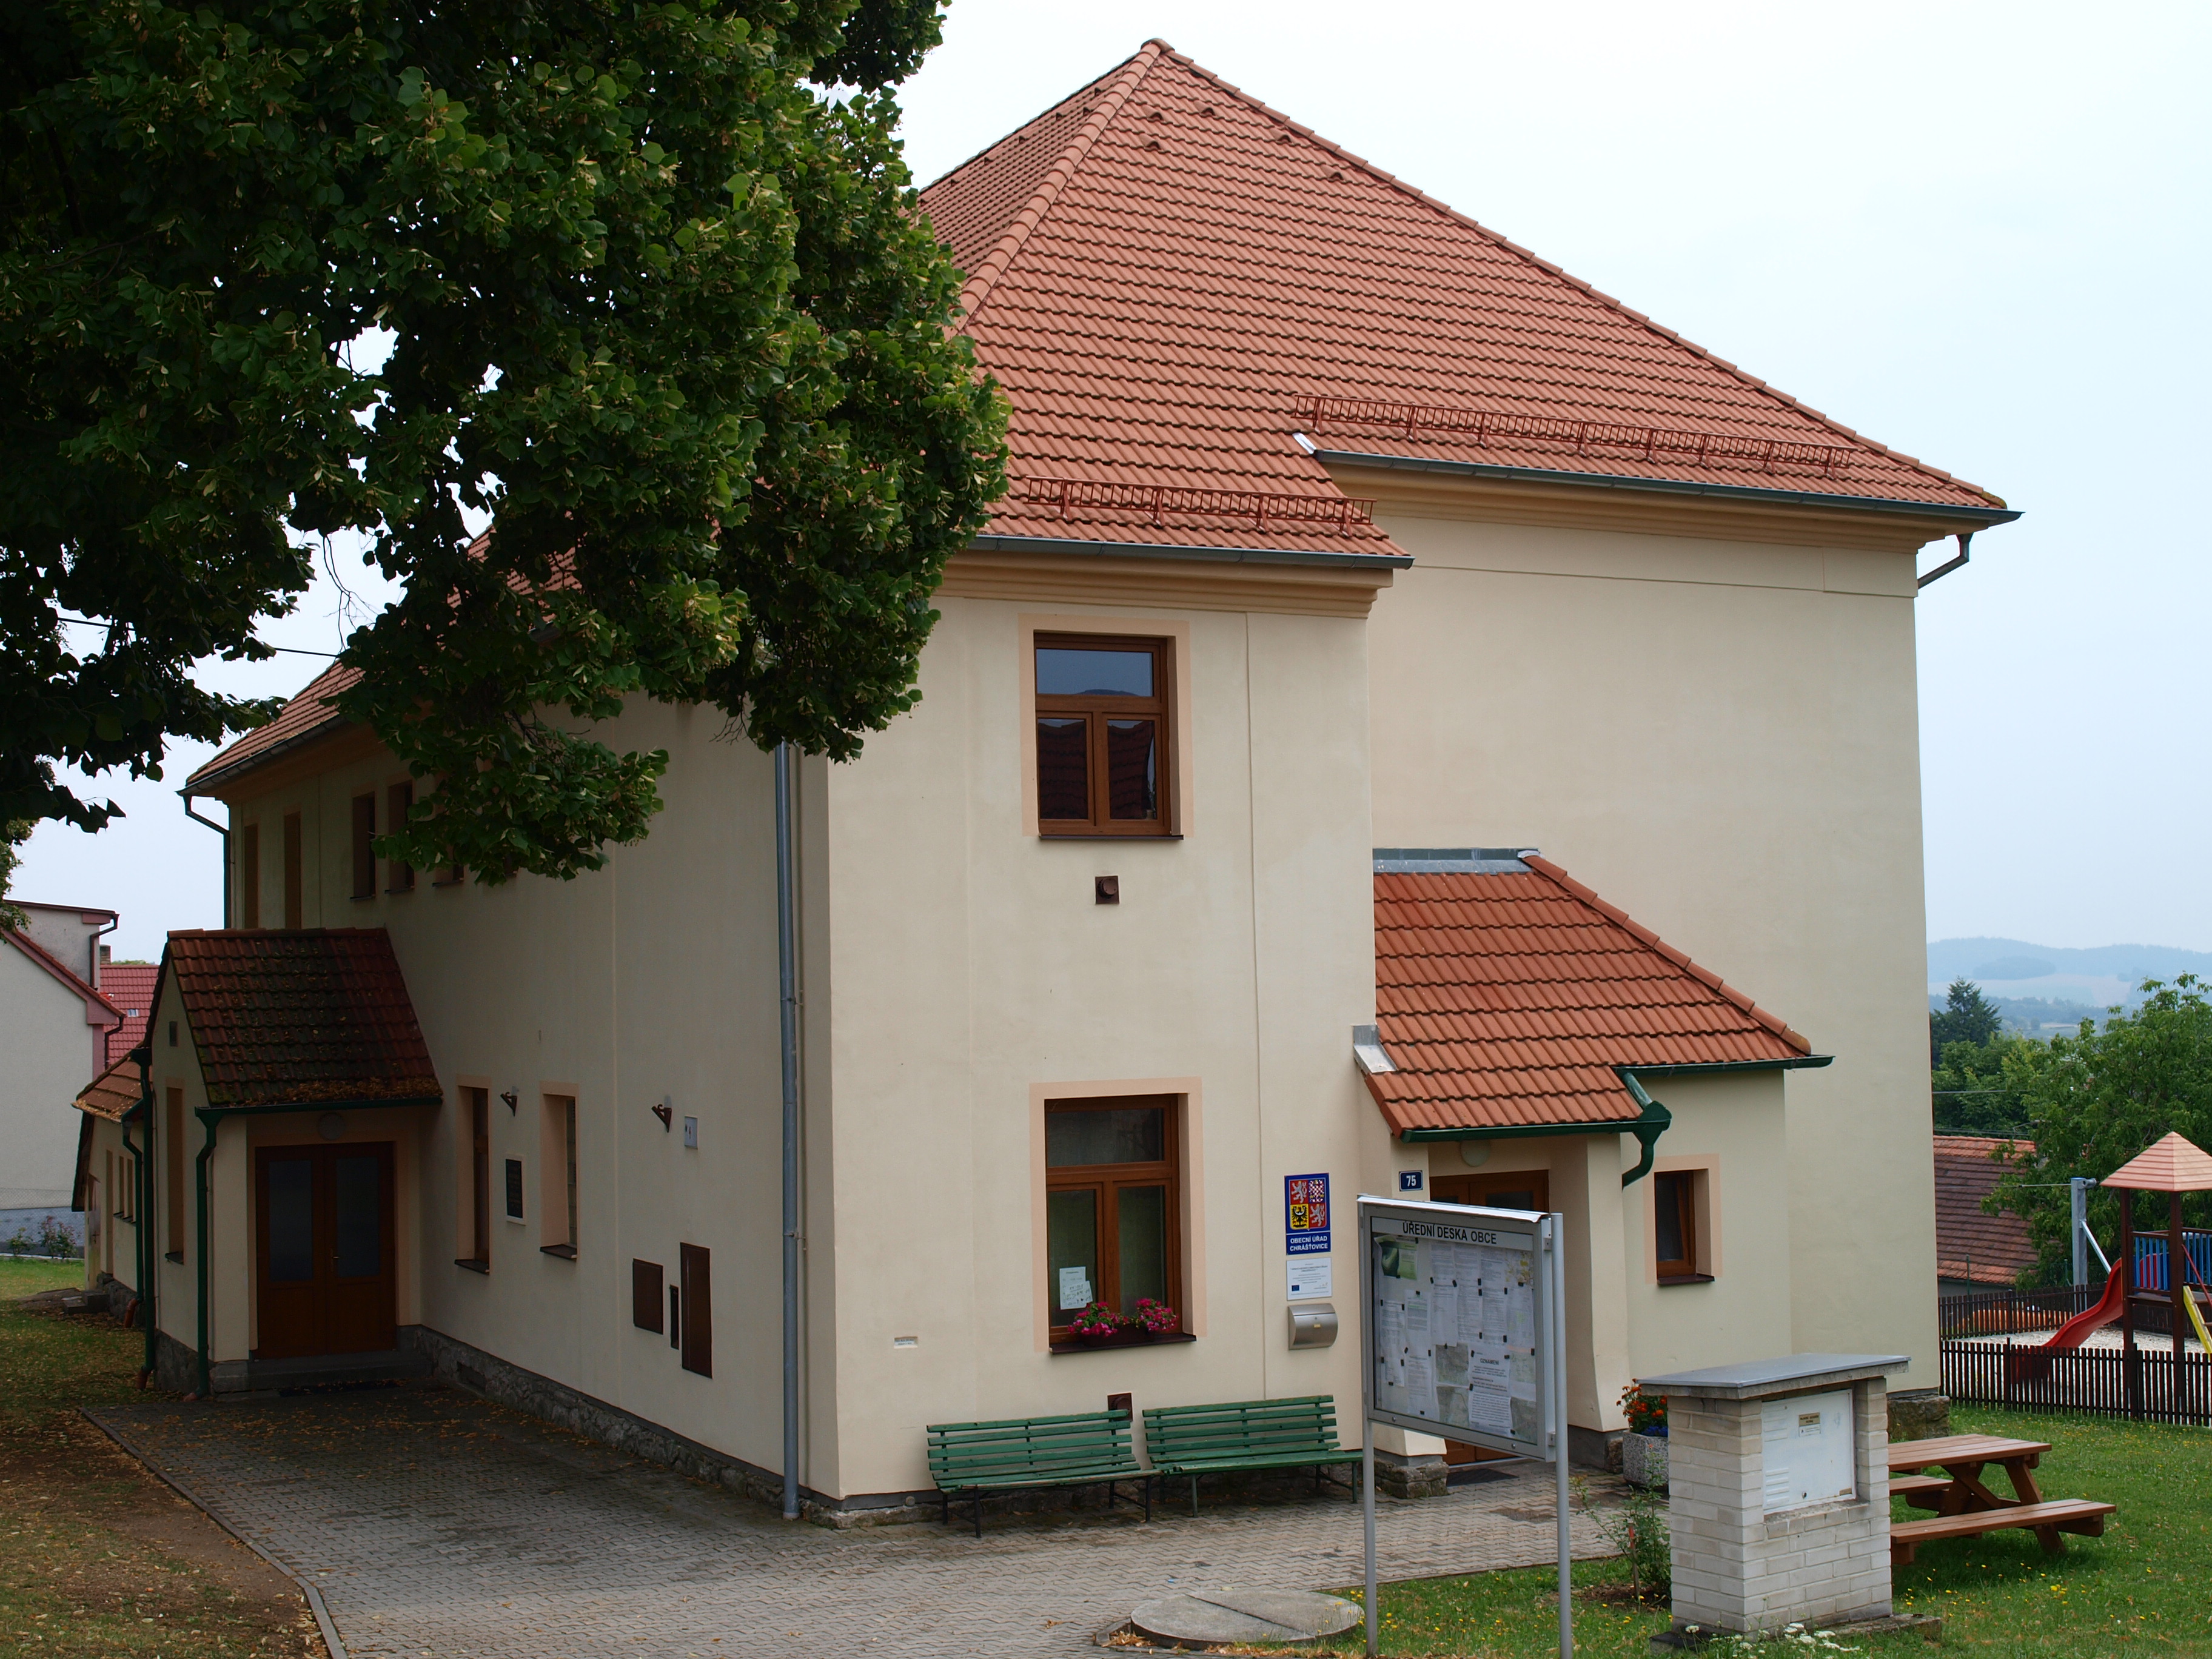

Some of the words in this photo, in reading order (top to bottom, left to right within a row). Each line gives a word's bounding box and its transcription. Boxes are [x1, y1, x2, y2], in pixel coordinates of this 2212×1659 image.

[1406, 1175, 1416, 1187] 75
[1403, 1221, 1435, 1237] ÚŘEDNÍ
[1437, 1226, 1467, 1241] DESKA
[1471, 1231, 1496, 1244] OBCE
